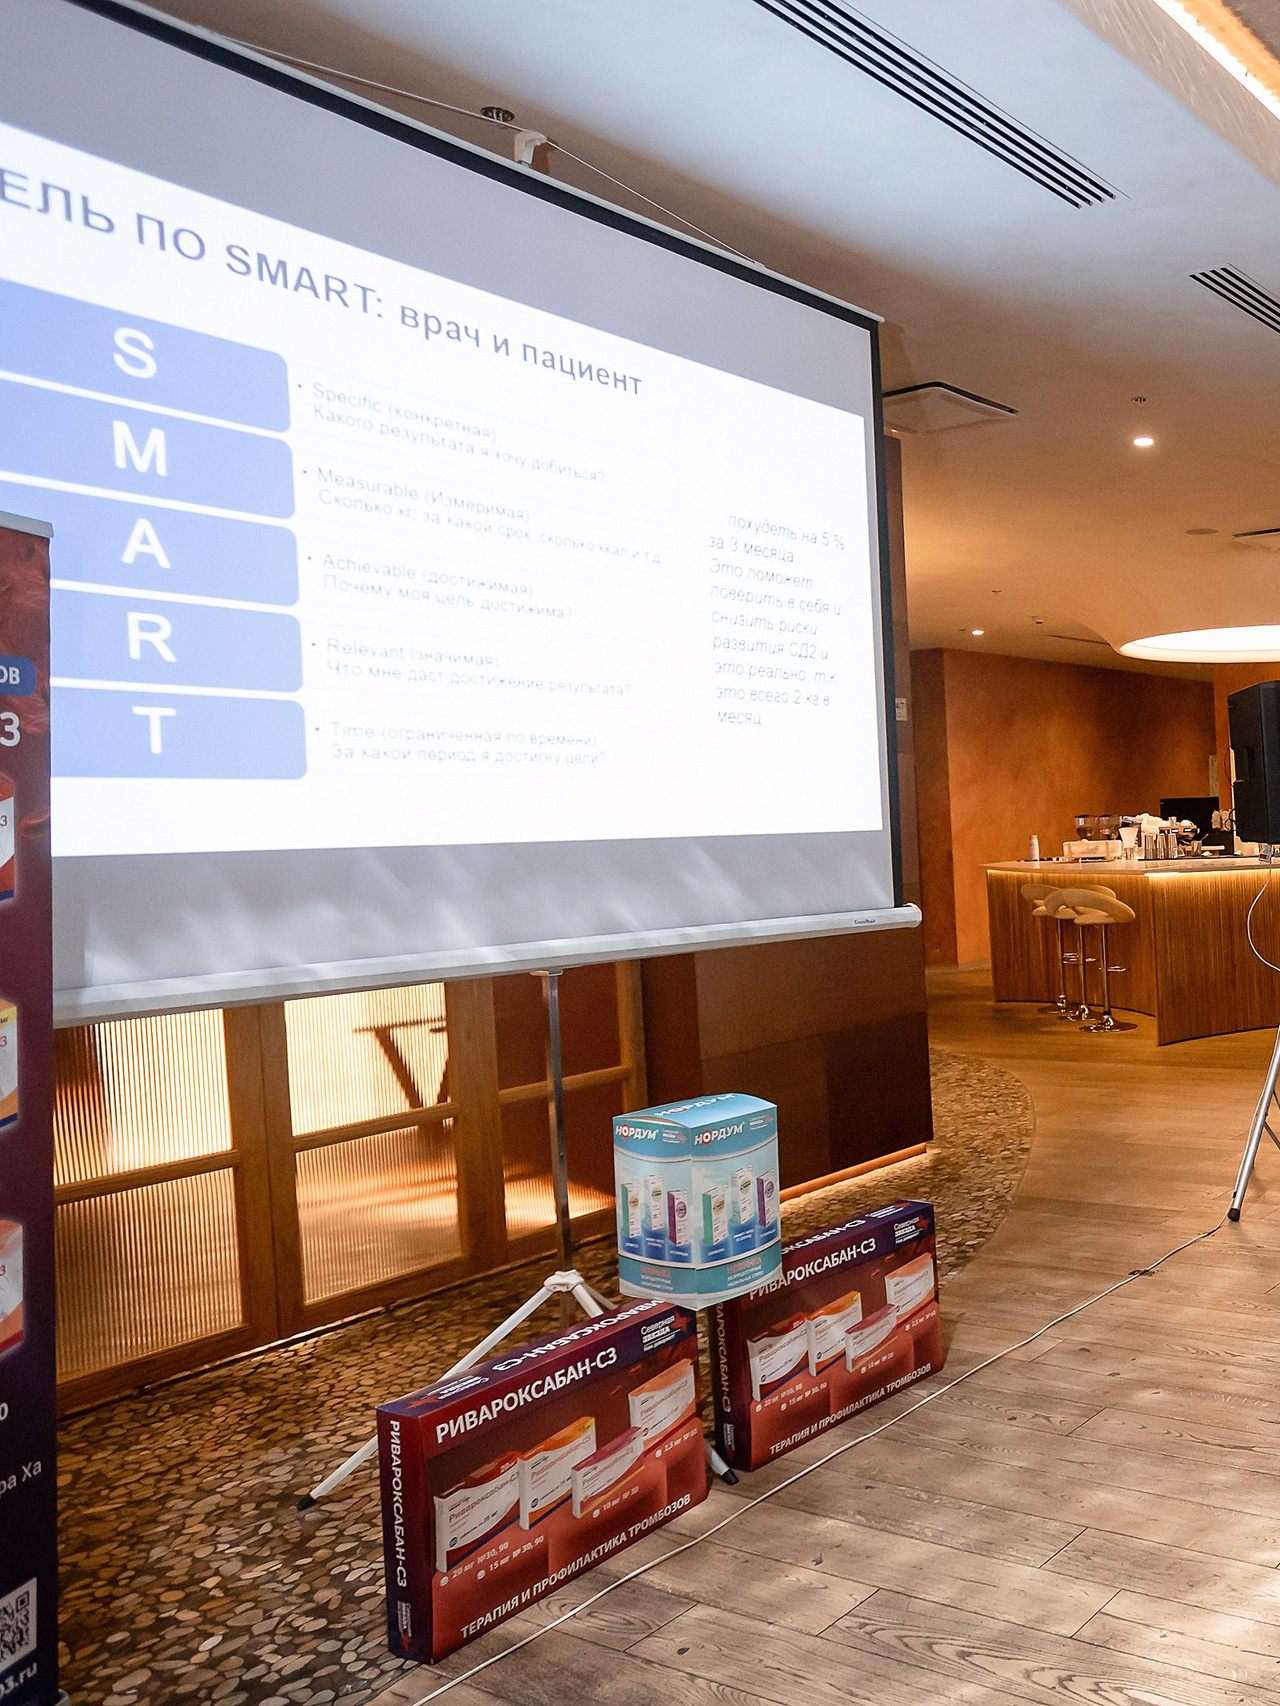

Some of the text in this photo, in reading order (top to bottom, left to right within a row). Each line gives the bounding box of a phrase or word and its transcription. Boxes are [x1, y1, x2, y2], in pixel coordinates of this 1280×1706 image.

[136, 213, 206, 260] ПО
[225, 244, 383, 319] SMART:
[400, 305, 480, 348] врач
[493, 334, 510, 357] и
[521, 343, 643, 396] пациент
[113, 327, 158, 379] S
[313, 382, 382, 413] Specific
[313, 405, 374, 431] Какого
[112, 420, 168, 477] M
[317, 467, 418, 501] Measurable
[319, 489, 392, 516] Сколько
[121, 517, 171, 569] A
[728, 515, 845, 551] похудеть на 5 %
[708, 536, 795, 563] за 3 месяца
[322, 552, 416, 580] Achievable
[709, 557, 814, 589] Это поможет
[324, 574, 392, 599] Почему
[398, 588, 430, 601] моя
[710, 585, 784, 608] поверить
[787, 598, 796, 610] в
[799, 598, 830, 616] себя
[127, 612, 177, 663] R
[711, 610, 818, 636] снизить риски
[326, 638, 405, 660] Relevant
[712, 636, 785, 656] развития
[788, 642, 817, 660] СД2
[327, 661, 361, 677] Что
[369, 666, 401, 680] мне
[714, 661, 744, 676] это
[715, 687, 831, 706] это всего 2 кг в
[132, 706, 177, 754] T
[330, 721, 374, 740] Time
[717, 710, 762, 727] месяц
[491, 1299, 666, 1371] ИВАРОКСАБАН-СЗ
[769, 1427, 810, 1456] ТЕРАПИЯ
[810, 1420, 819, 1435] И
[819, 1390, 885, 1430] ПРОФИЛАКТИКА
[885, 1362, 932, 1397] ТРОМБОЗОВ
[460, 1595, 520, 1640] ТЕРАПИЯ
[521, 1588, 531, 1602] И
[533, 1534, 627, 1598] ПРОФИЛАКТИКА
[628, 1493, 691, 1547] ТРОМБОЗОВ
